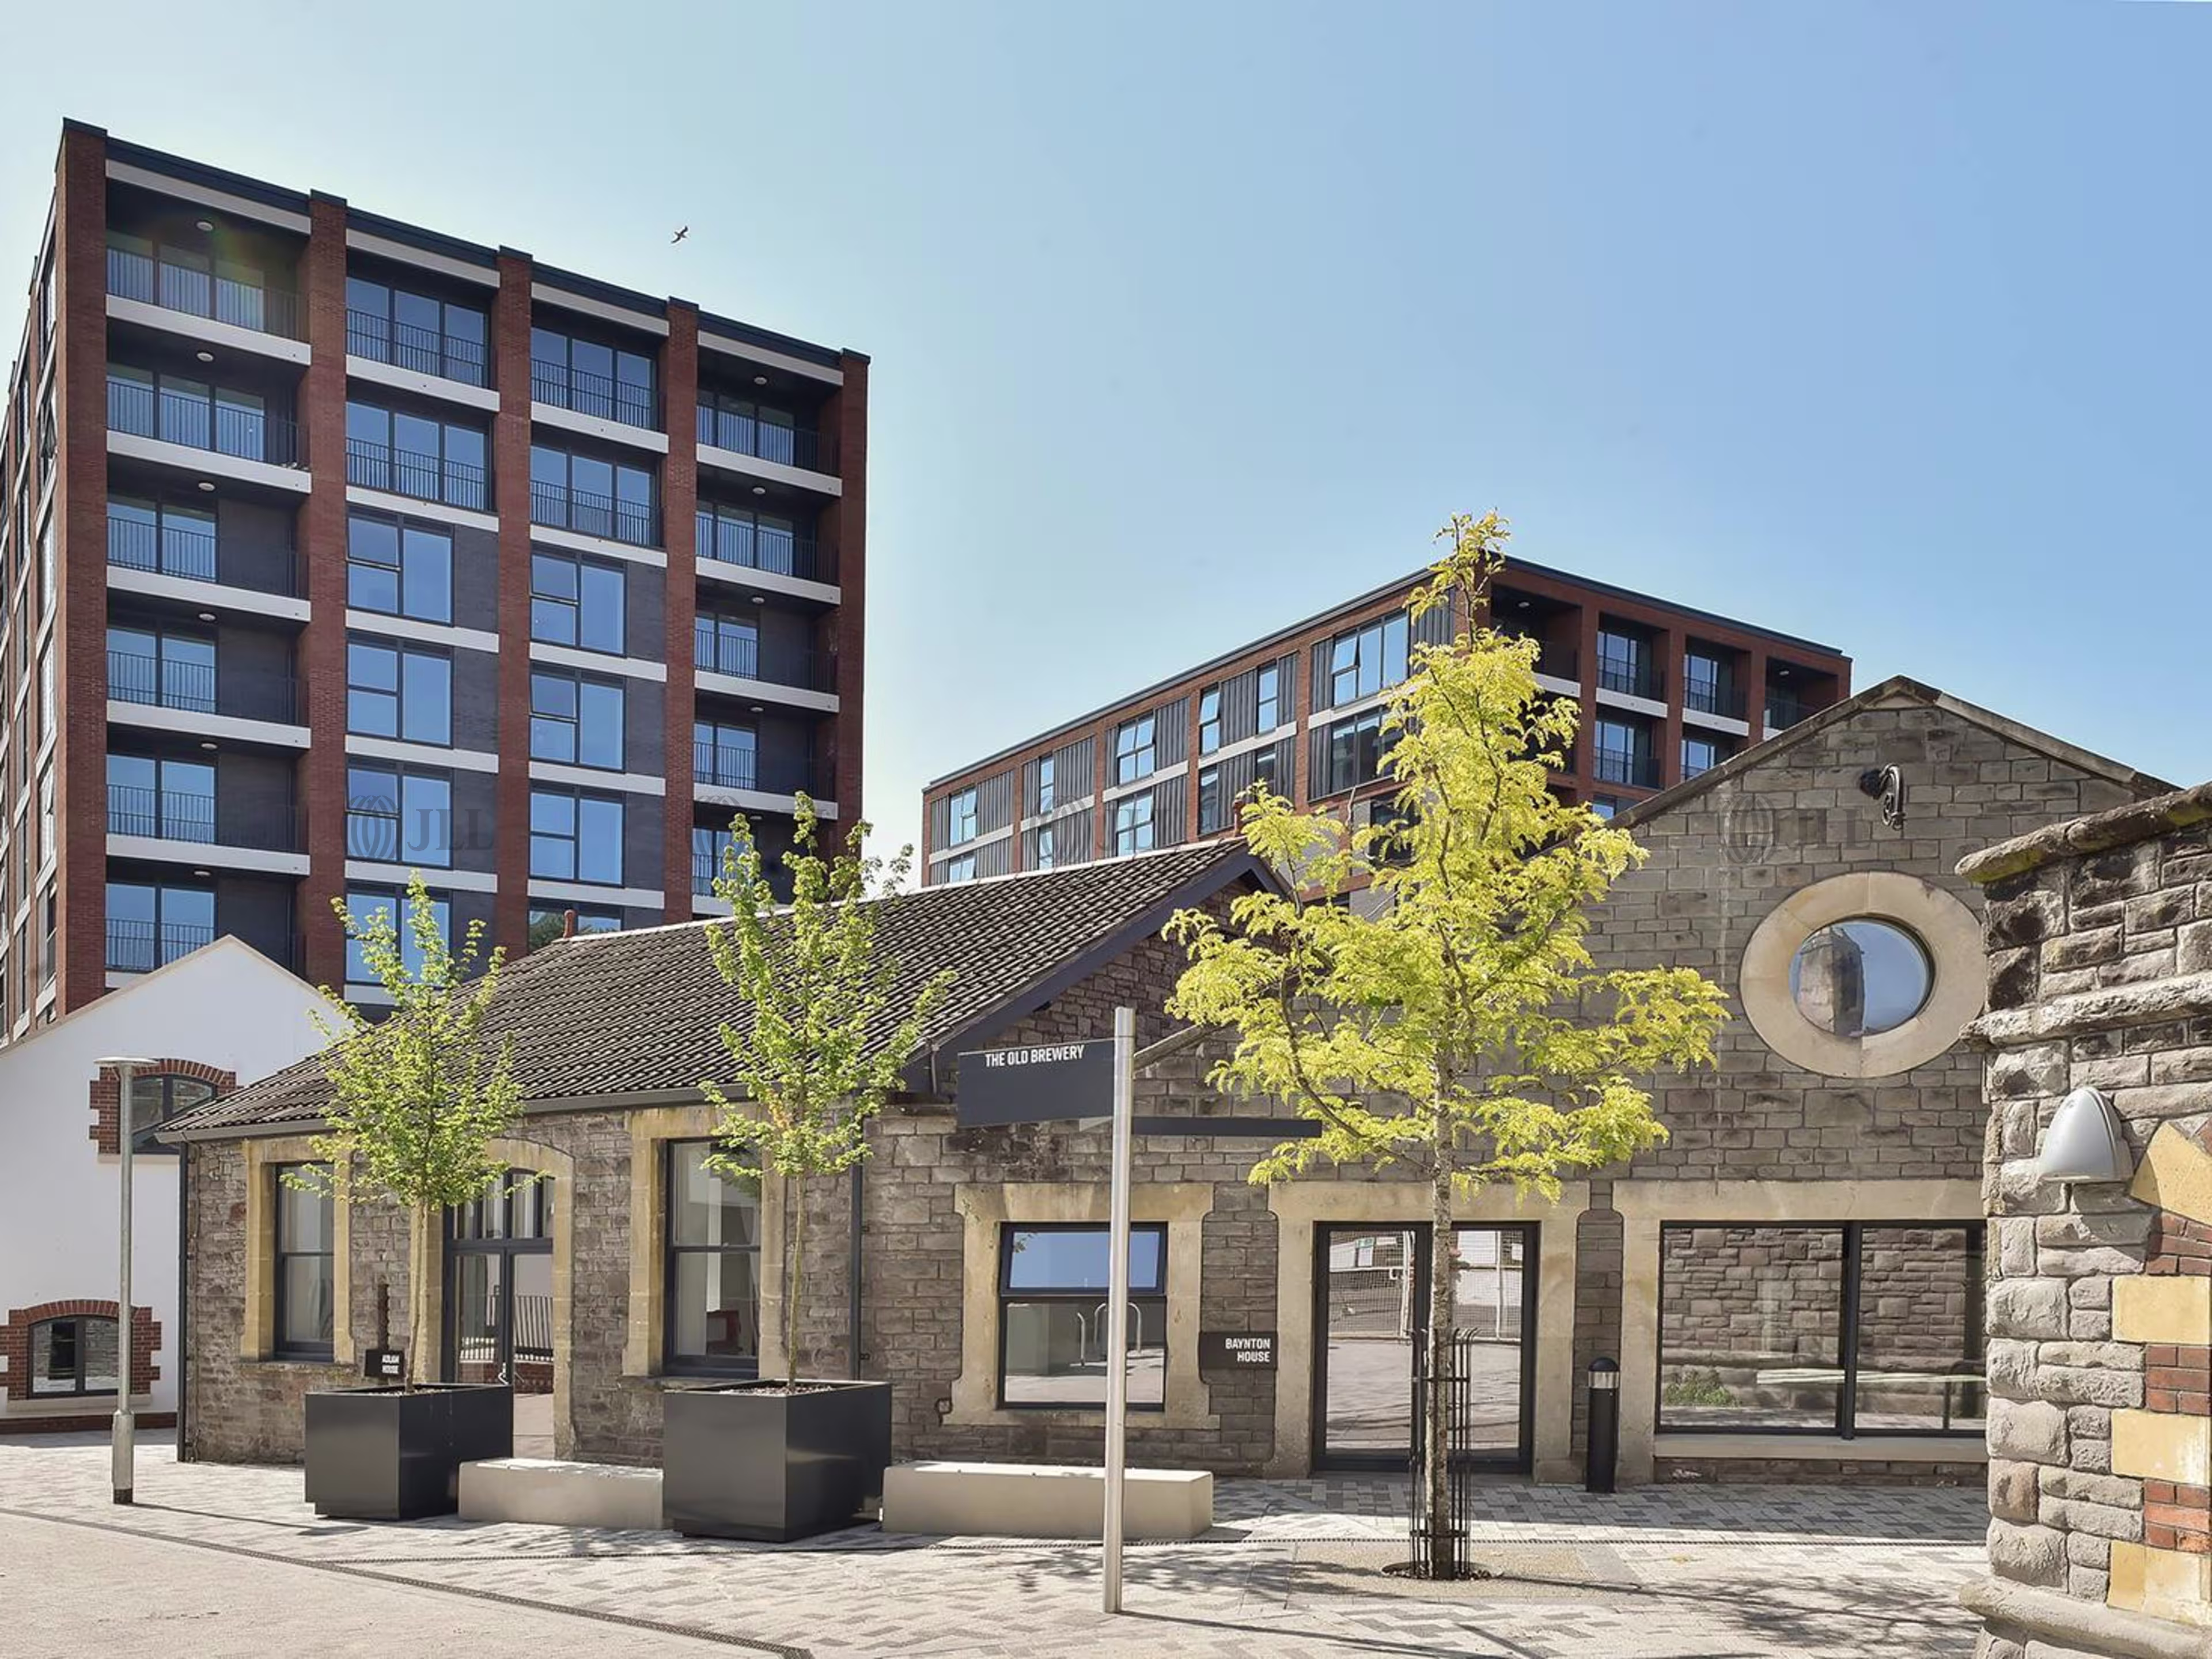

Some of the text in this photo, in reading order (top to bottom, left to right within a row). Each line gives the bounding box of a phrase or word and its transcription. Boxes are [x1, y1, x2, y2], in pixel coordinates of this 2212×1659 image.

[985, 1044, 1085, 1067] THE OLD BREWERY
[1225, 1338, 1271, 1350] BAYNTON
[1237, 1351, 1271, 1362] HOUSE
